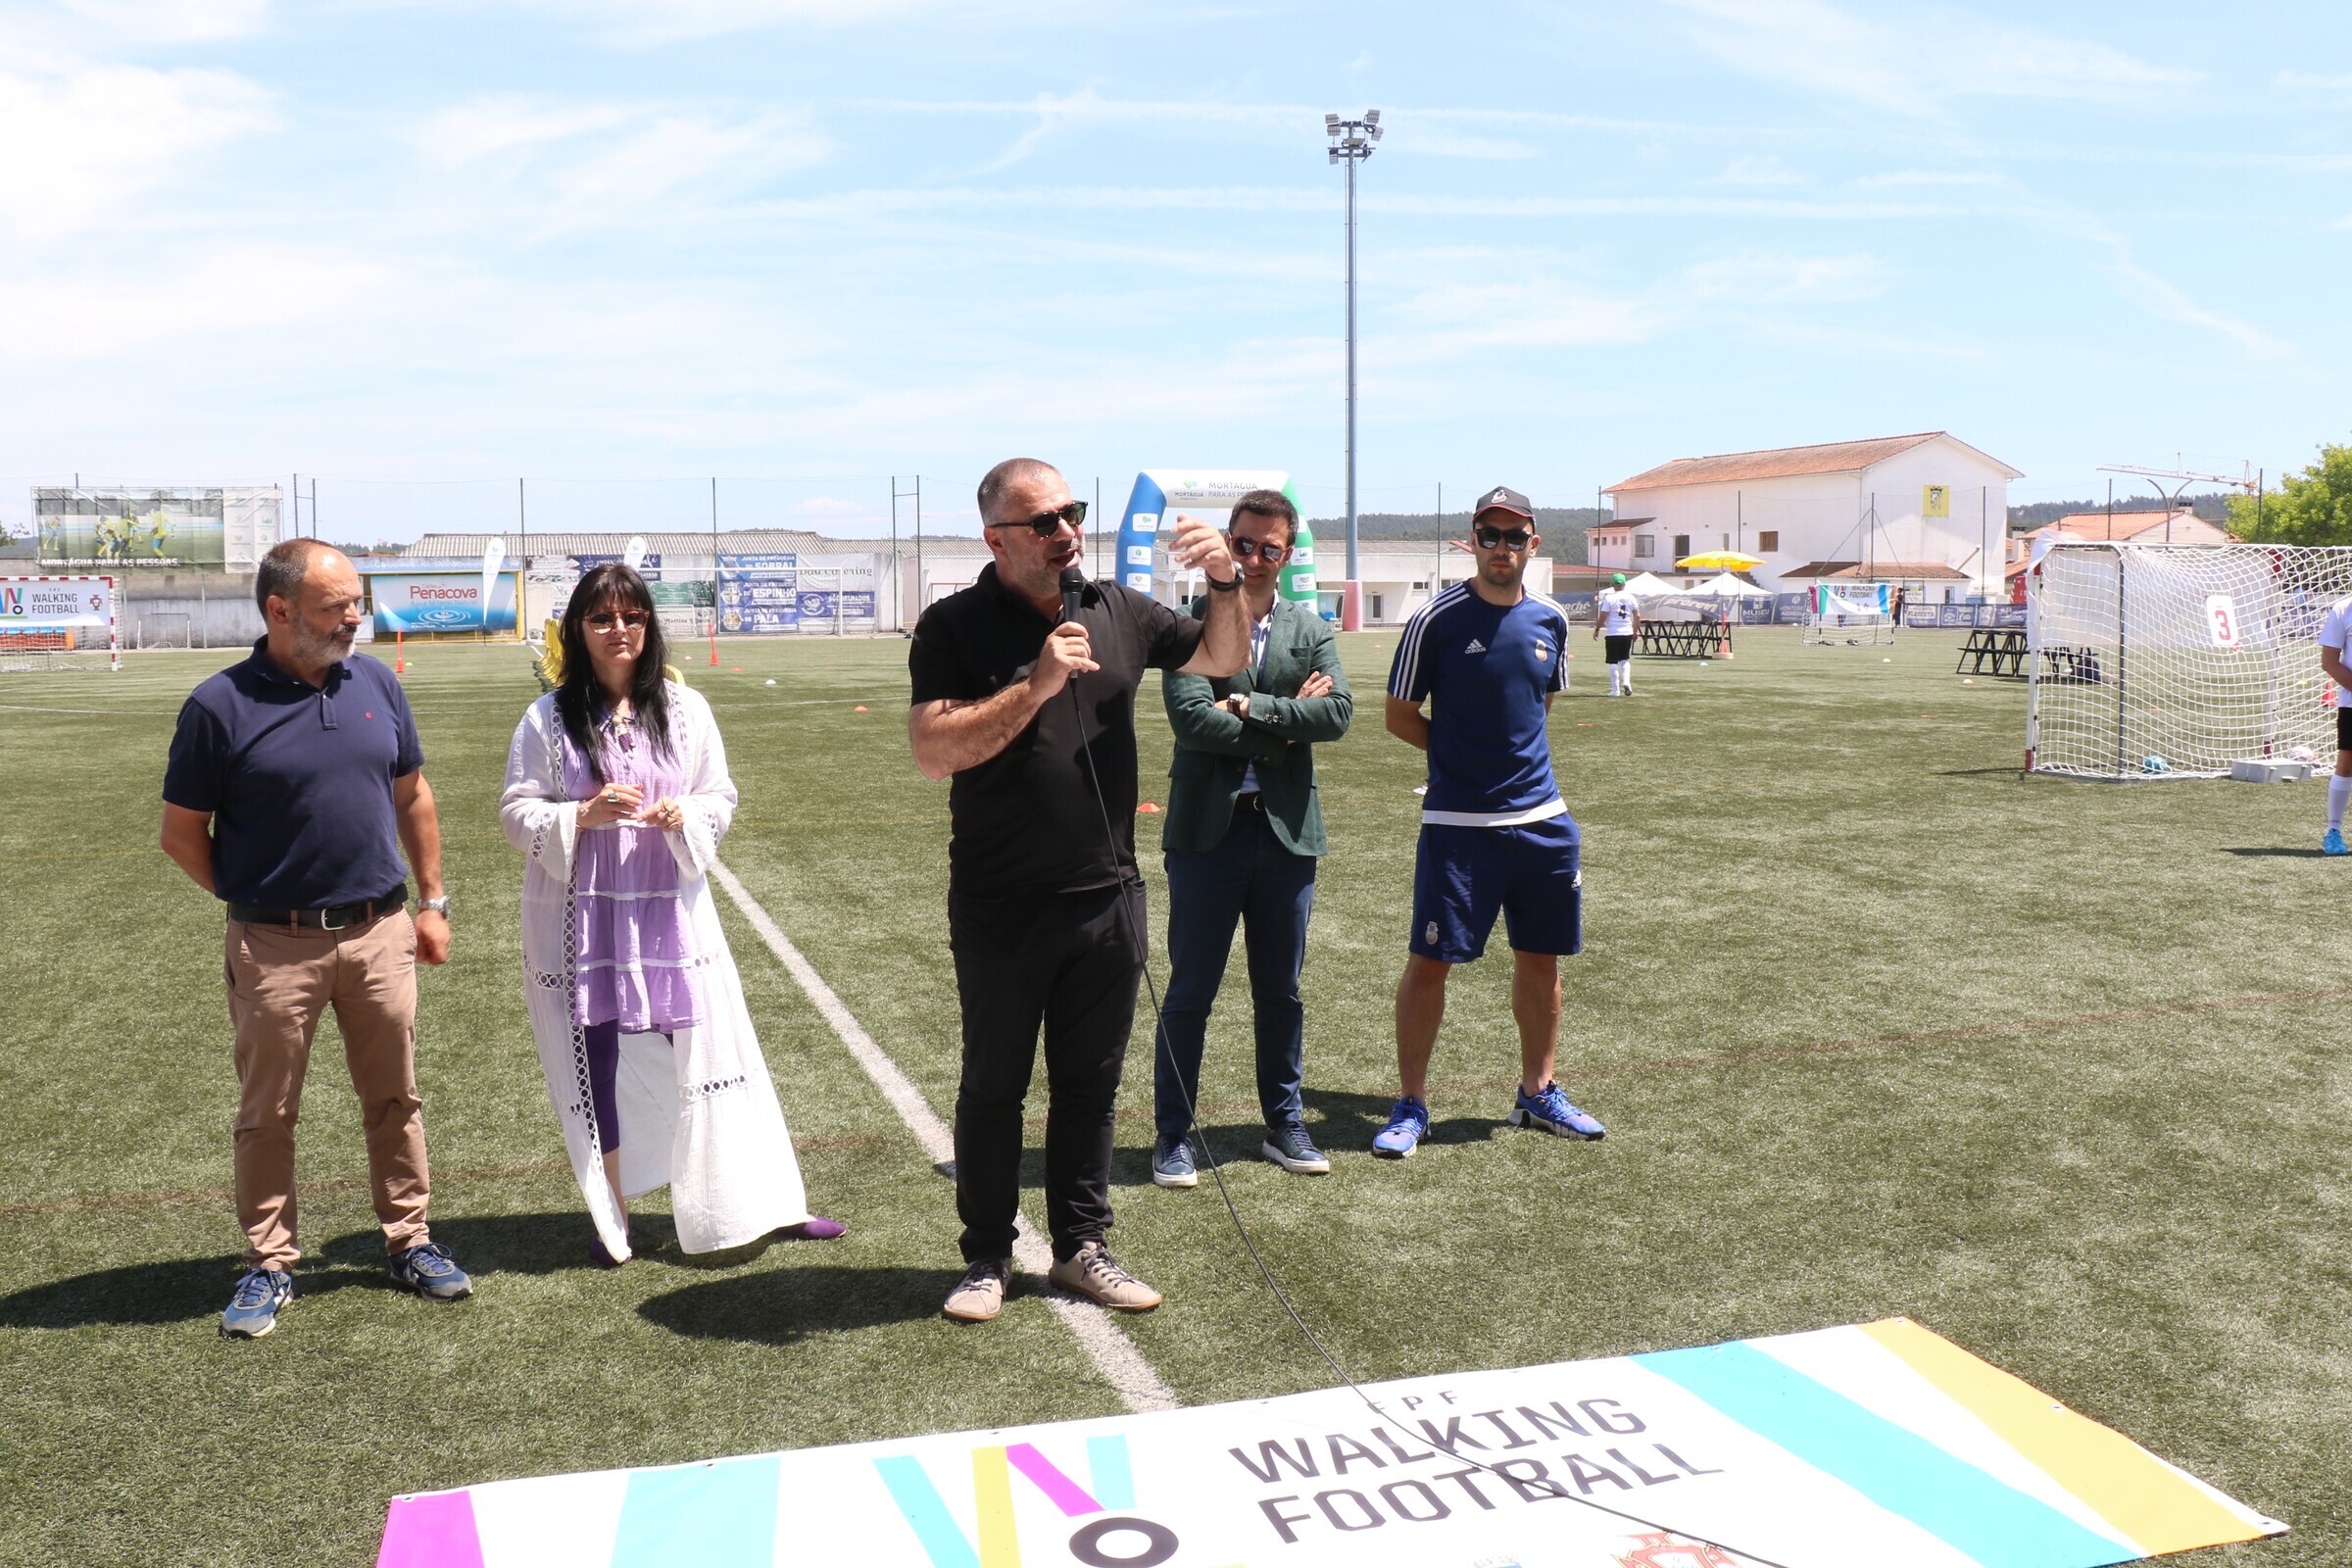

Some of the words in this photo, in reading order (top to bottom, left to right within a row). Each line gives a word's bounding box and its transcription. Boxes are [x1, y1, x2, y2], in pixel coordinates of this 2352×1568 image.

[824, 566, 872, 576] Caering
[32, 593, 77, 603] WALKING
[410, 585, 477, 600] Penacova
[753, 588, 797, 598] ESPINHO
[32, 605, 79, 613] FOOTBALL
[1618, 605, 1626, 619] 4
[754, 613, 780, 624] PALA
[2214, 610, 2231, 640] 3
[1464, 646, 1487, 655] adidas
[1227, 1398, 1647, 1484] WALKING
[1257, 1444, 1725, 1544] FOOTBALL
